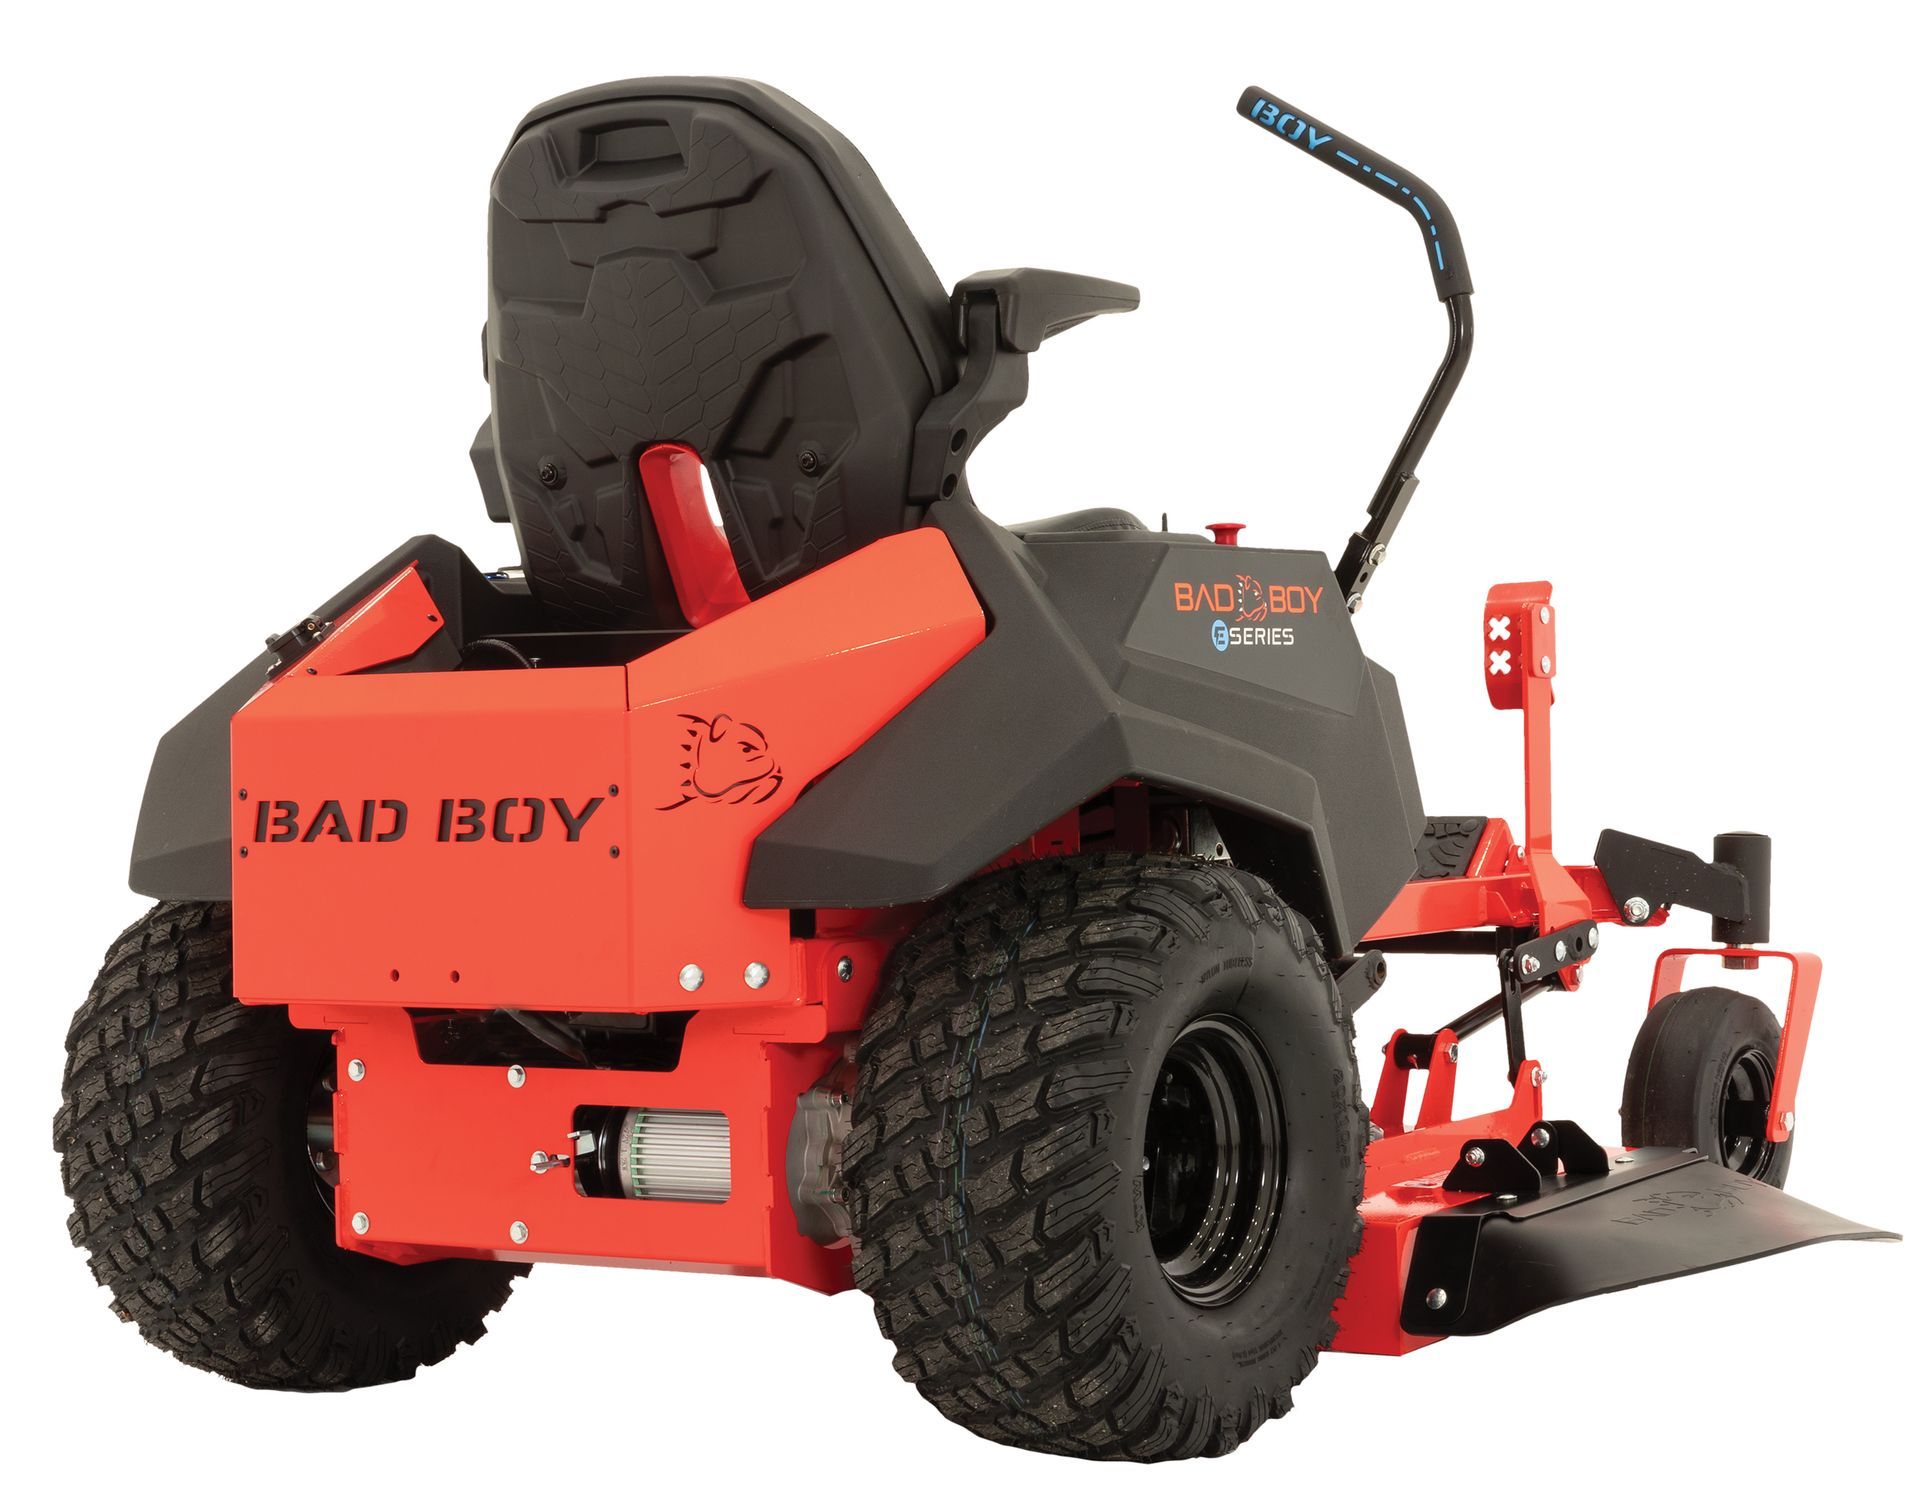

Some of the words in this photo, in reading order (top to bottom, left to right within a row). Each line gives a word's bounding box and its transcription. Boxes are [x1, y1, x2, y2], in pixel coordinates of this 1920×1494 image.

[1250, 97, 1333, 151] BOY
[1174, 582, 1235, 612] BAD
[1268, 585, 1323, 614] BOY
[1229, 627, 1295, 646] SERIES
[254, 798, 409, 844] BAD
[436, 796, 606, 844] BOY
